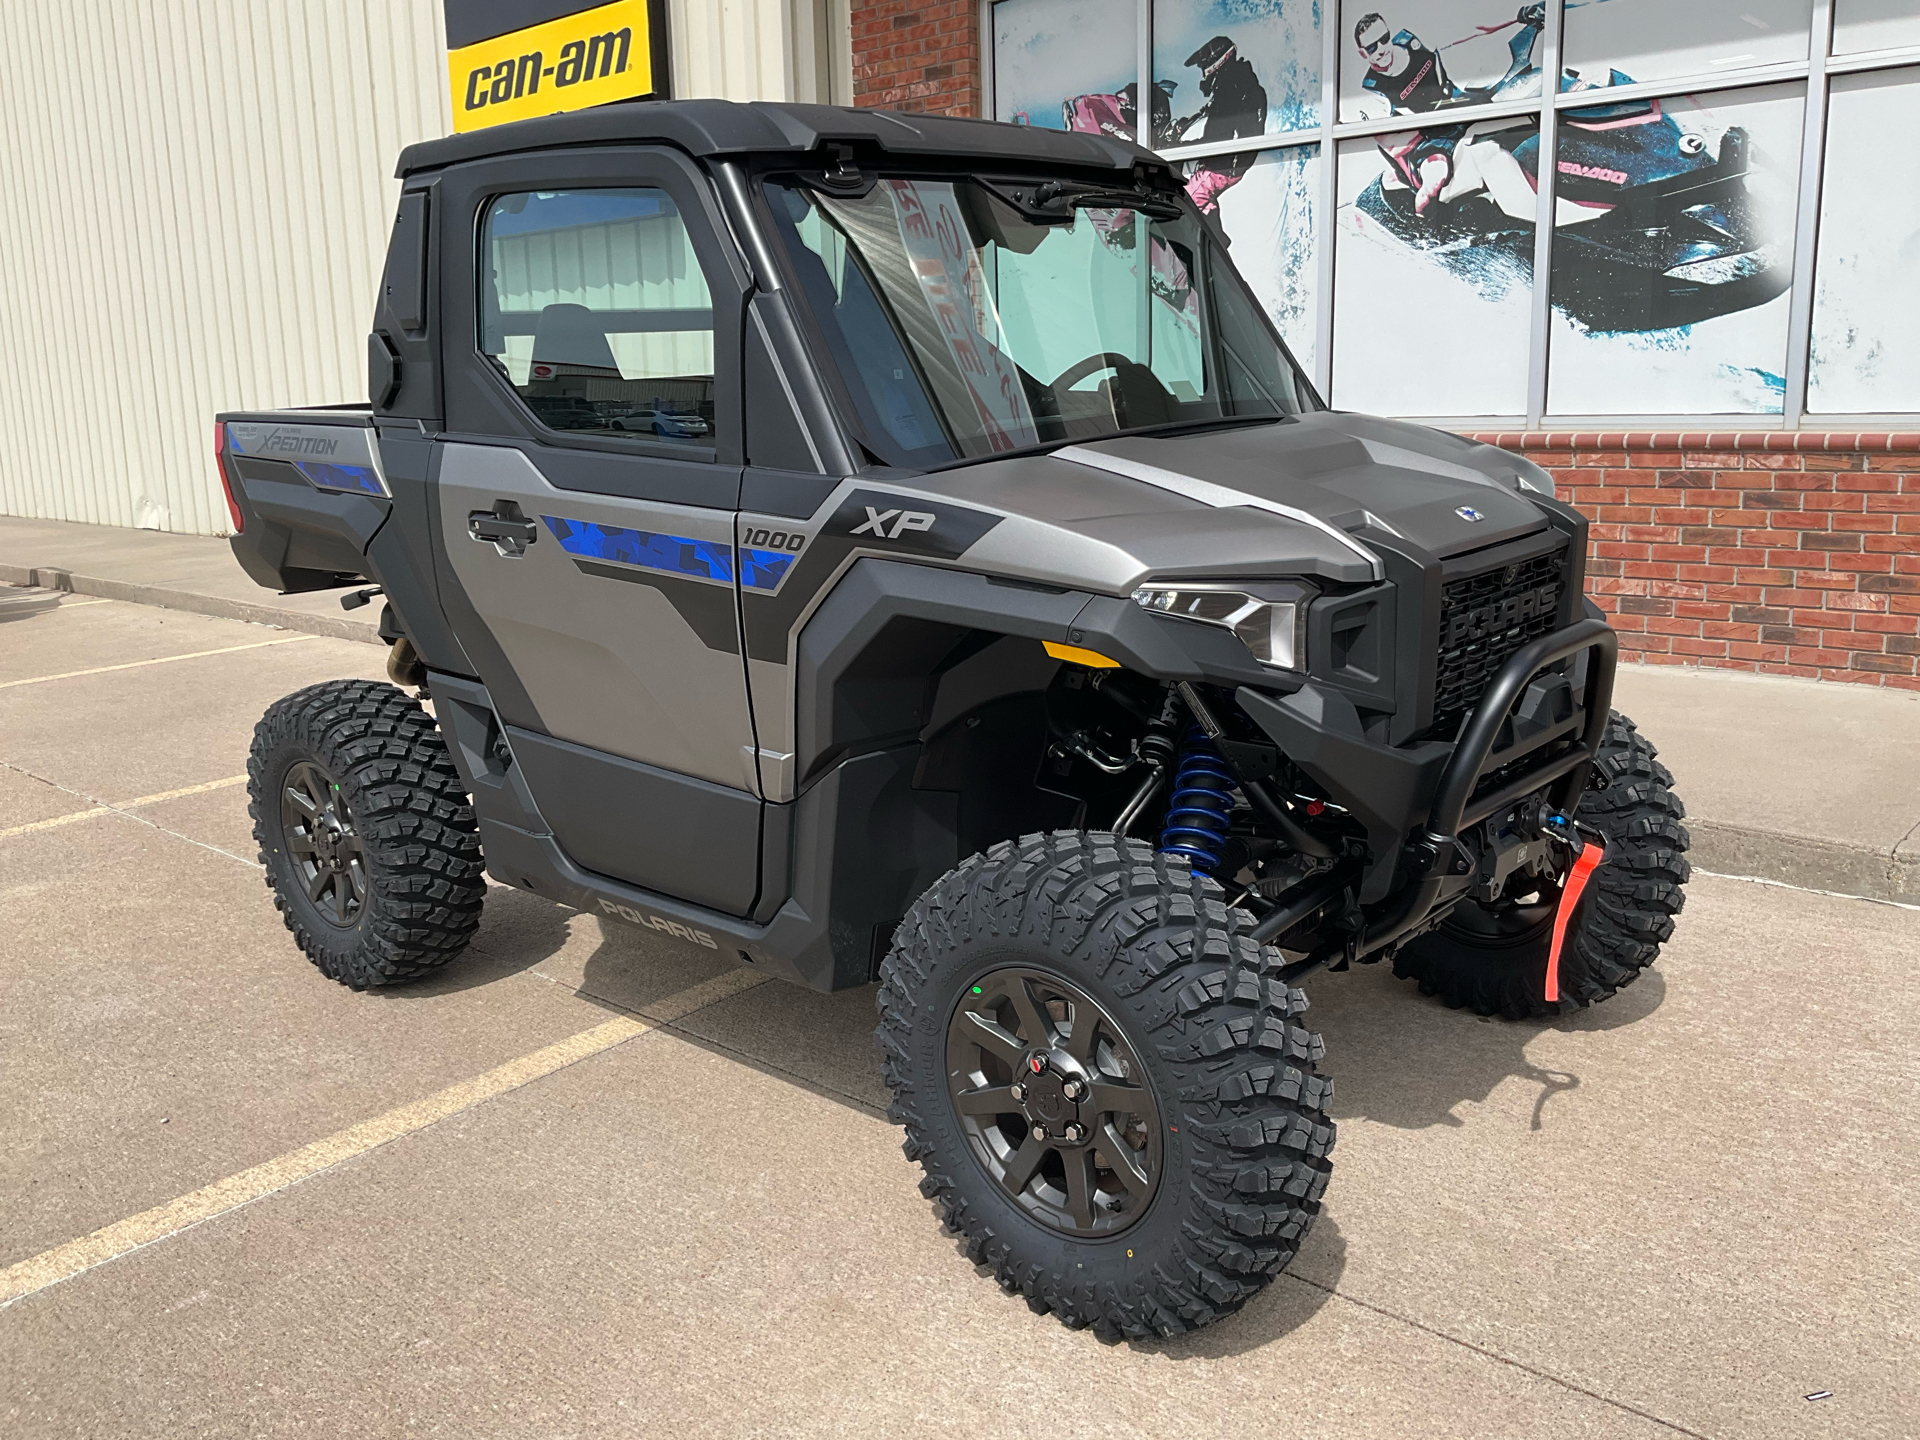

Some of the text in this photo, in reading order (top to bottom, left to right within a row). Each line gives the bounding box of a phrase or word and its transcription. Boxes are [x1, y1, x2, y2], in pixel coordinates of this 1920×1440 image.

[465, 27, 632, 111] can-am
[256, 427, 339, 455] XPEDITION
[743, 527, 806, 551] 1000
[849, 506, 936, 539] XP
[1446, 582, 1558, 647] POLARIS
[597, 898, 719, 950] POLARIS
